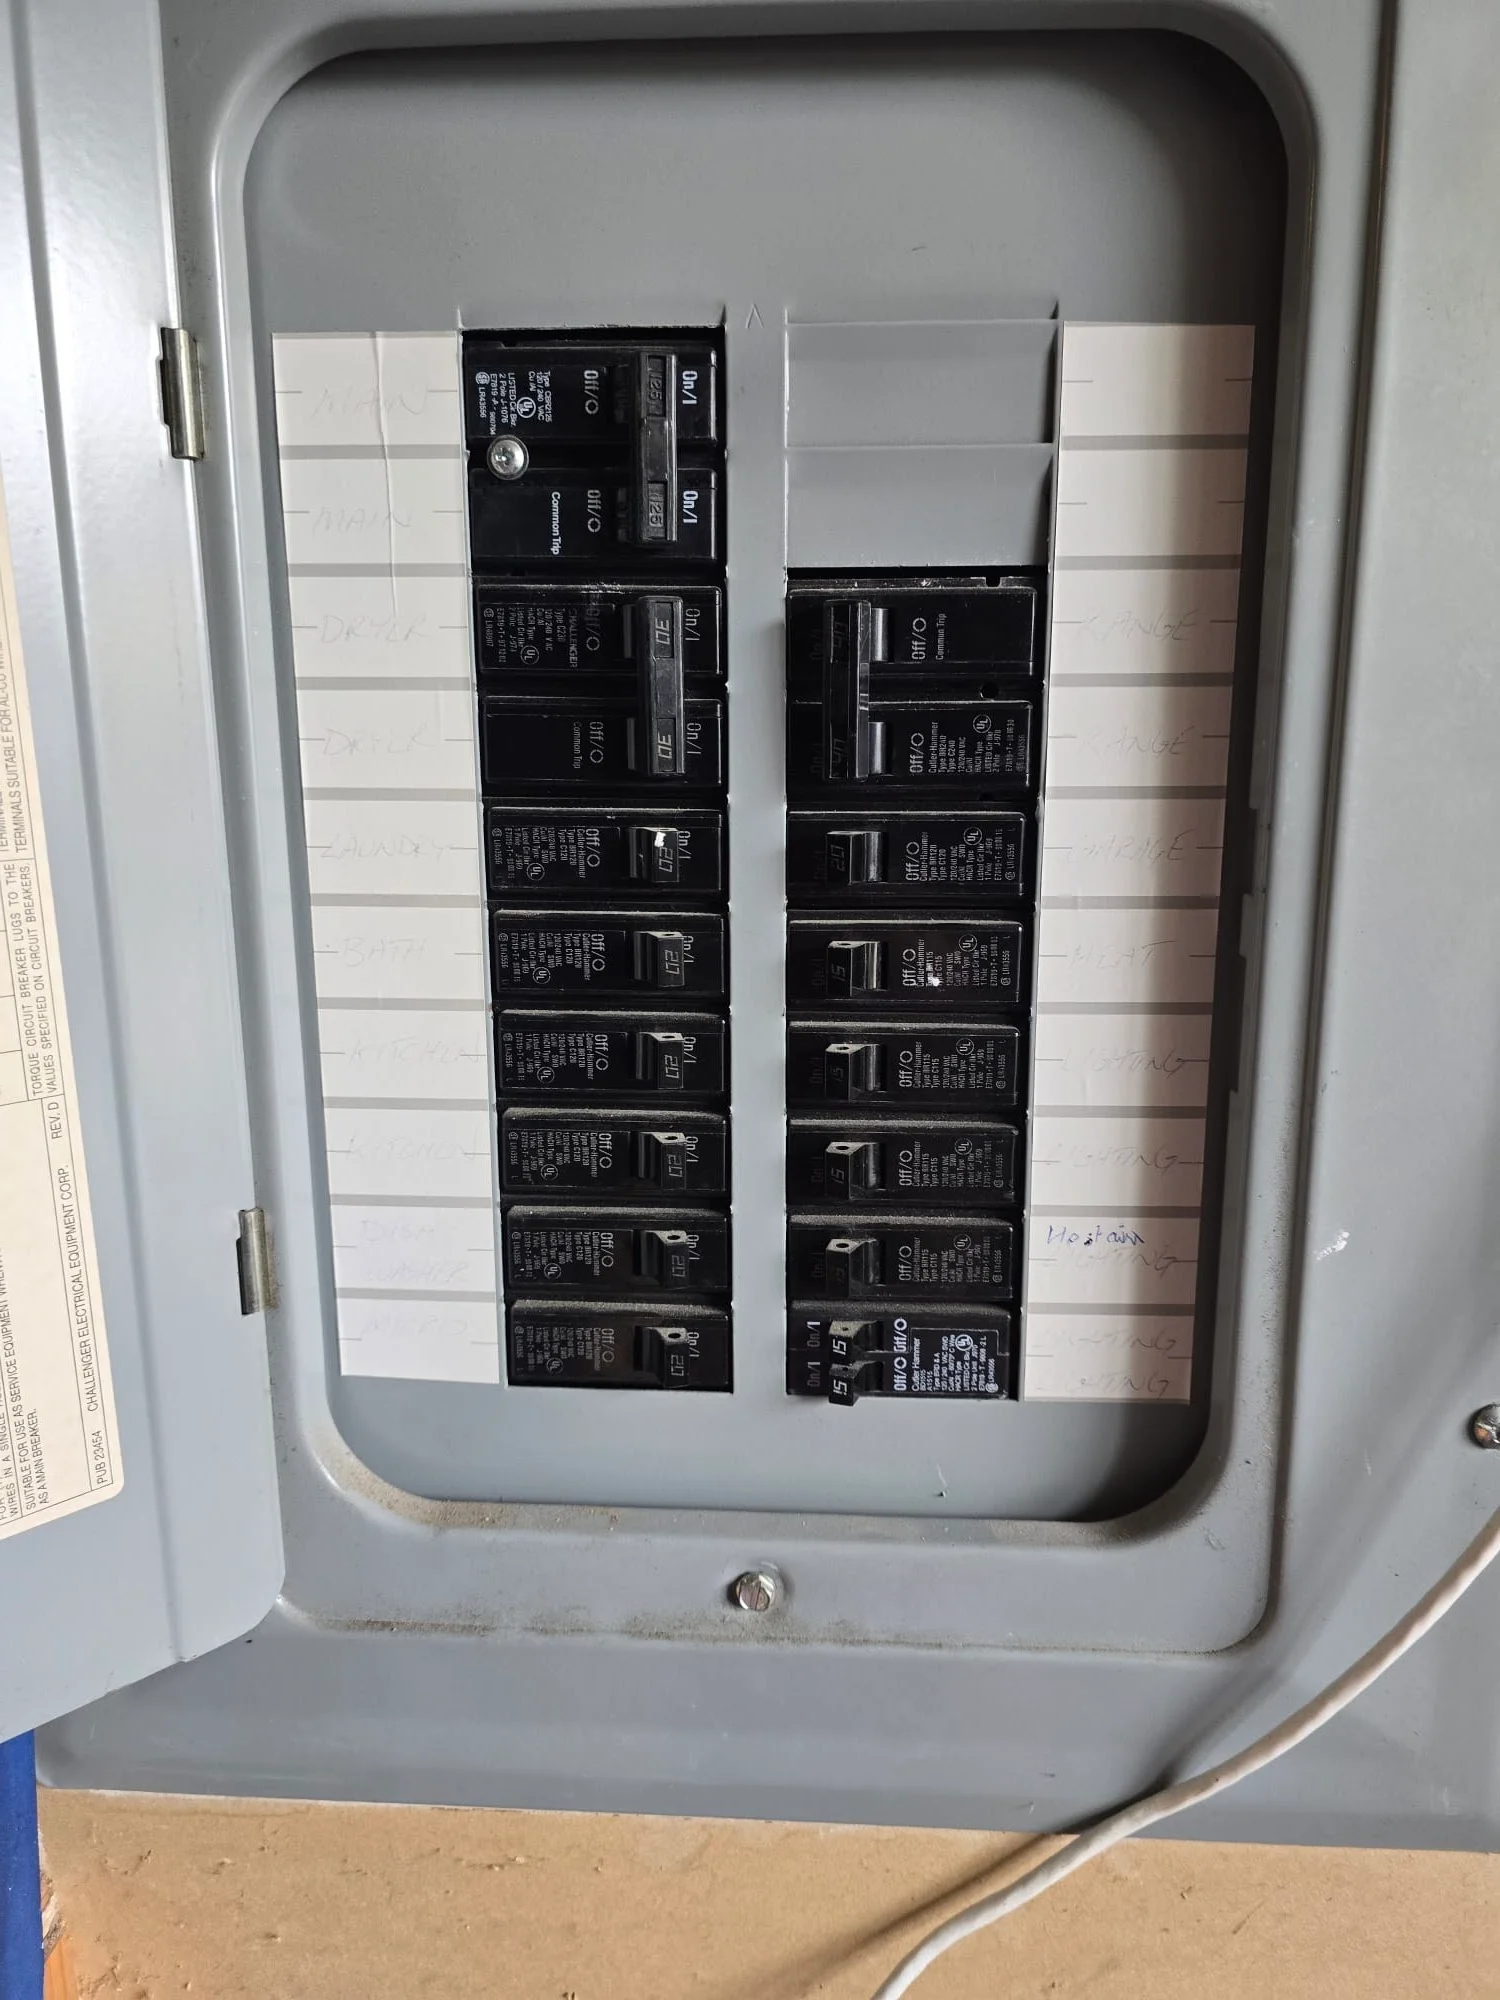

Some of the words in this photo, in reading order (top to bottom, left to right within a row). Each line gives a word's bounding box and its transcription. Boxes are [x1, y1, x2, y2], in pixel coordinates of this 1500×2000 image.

[507, 372, 516, 400] LISTED
[550, 491, 562, 536] Common
[549, 538, 562, 556] Trip
[936, 613, 947, 628] Trip
[935, 628, 946, 661] Common
[0, 709, 12, 734] FOR
[572, 721, 583, 754] Common
[2, 735, 20, 788] SUITABLE
[570, 755, 584, 769] Trip
[9, 790, 28, 853] TERMINALS
[4, 863, 17, 884] THE
[8, 892, 19, 907] TO
[10, 912, 24, 942] LUGS
[27, 928, 42, 970] CIRCUIT
[15, 948, 31, 998] BREAKER
[33, 975, 44, 991] ON
[22, 1004, 37, 1047] CIRCUIT
[36, 996, 52, 1049] SPECIFIED
[27, 1052, 43, 1096] TORQUE
[43, 1054, 57, 1094] VALUES
[47, 1101, 59, 1111] D
[49, 1112, 62, 1140] REV.
[57, 1164, 72, 1200] CORP.
[62, 1203, 80, 1268] EQUIPMENT
[69, 1268, 90, 1338] ELECTRICAL
[0, 1298, 15, 1358] EQUIPMENT
[832, 1338, 847, 1356] 15
[911, 1337, 921, 1369] Hammer
[5, 1358, 22, 1403] SERVICE
[78, 1339, 100, 1413] CHALLENGER
[12, 1404, 24, 1417] AS
[14, 1419, 26, 1440] USE
[28, 1408, 42, 1458] BREAKER.
[2, 1454, 11, 1463] A
[18, 1442, 30, 1463] FOR
[91, 1430, 104, 1461] 23454
[4, 1467, 13, 1478] IN
[33, 1458, 46, 1482] MAIN
[95, 1462, 108, 1484] PUB
[5, 1482, 19, 1517] WIRES
[20, 1464, 36, 1510] SUITABLE
[38, 1491, 49, 1505] AS
